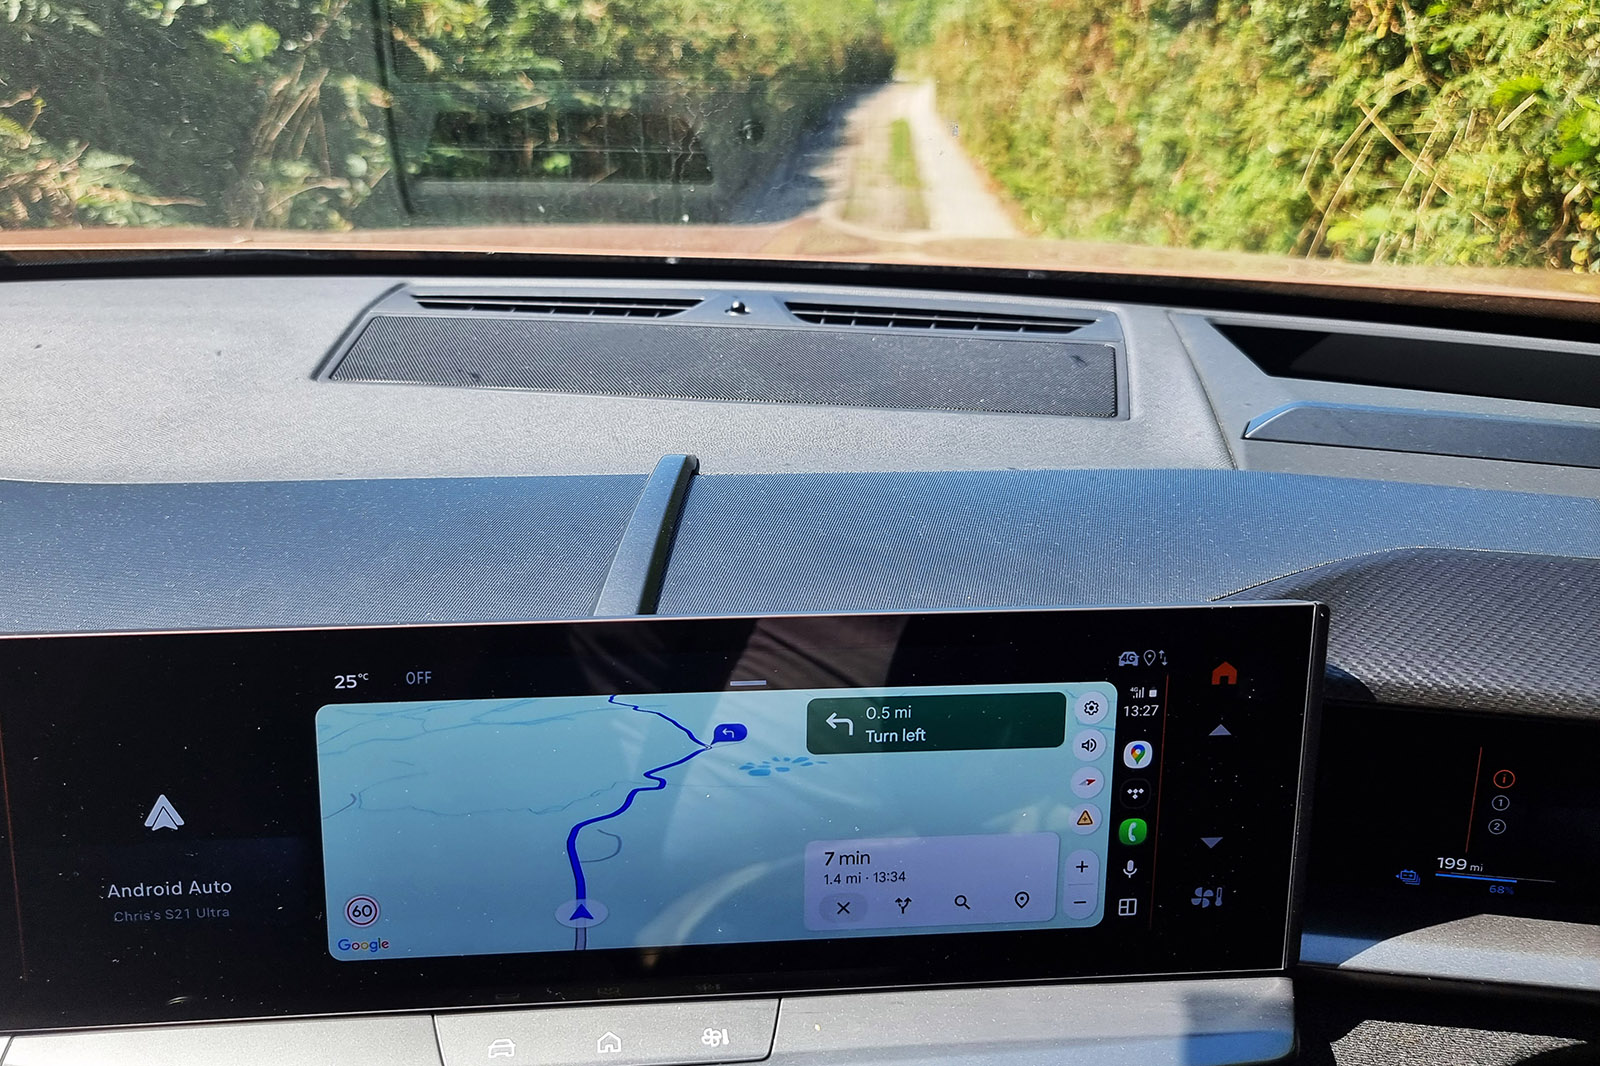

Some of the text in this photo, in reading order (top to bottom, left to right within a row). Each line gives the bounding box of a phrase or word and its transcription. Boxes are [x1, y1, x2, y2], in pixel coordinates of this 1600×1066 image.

[406, 671, 432, 685] OFF
[866, 705, 911, 720] 0.5 mi
[1123, 704, 1159, 717] 13:27
[866, 727, 926, 743] Turn left
[1498, 799, 1503, 807] 1
[1493, 822, 1500, 831] 2
[824, 850, 870, 866] 7 min
[1437, 857, 1483, 872] 199 mi
[824, 870, 906, 885] 1.4 mi 13:34
[107, 880, 232, 898] Android Auto
[1489, 885, 1514, 895] 68%
[113, 907, 230, 922] Chris's S21 Ultra
[352, 904, 373, 918] 60
[338, 937, 390, 953] Google
